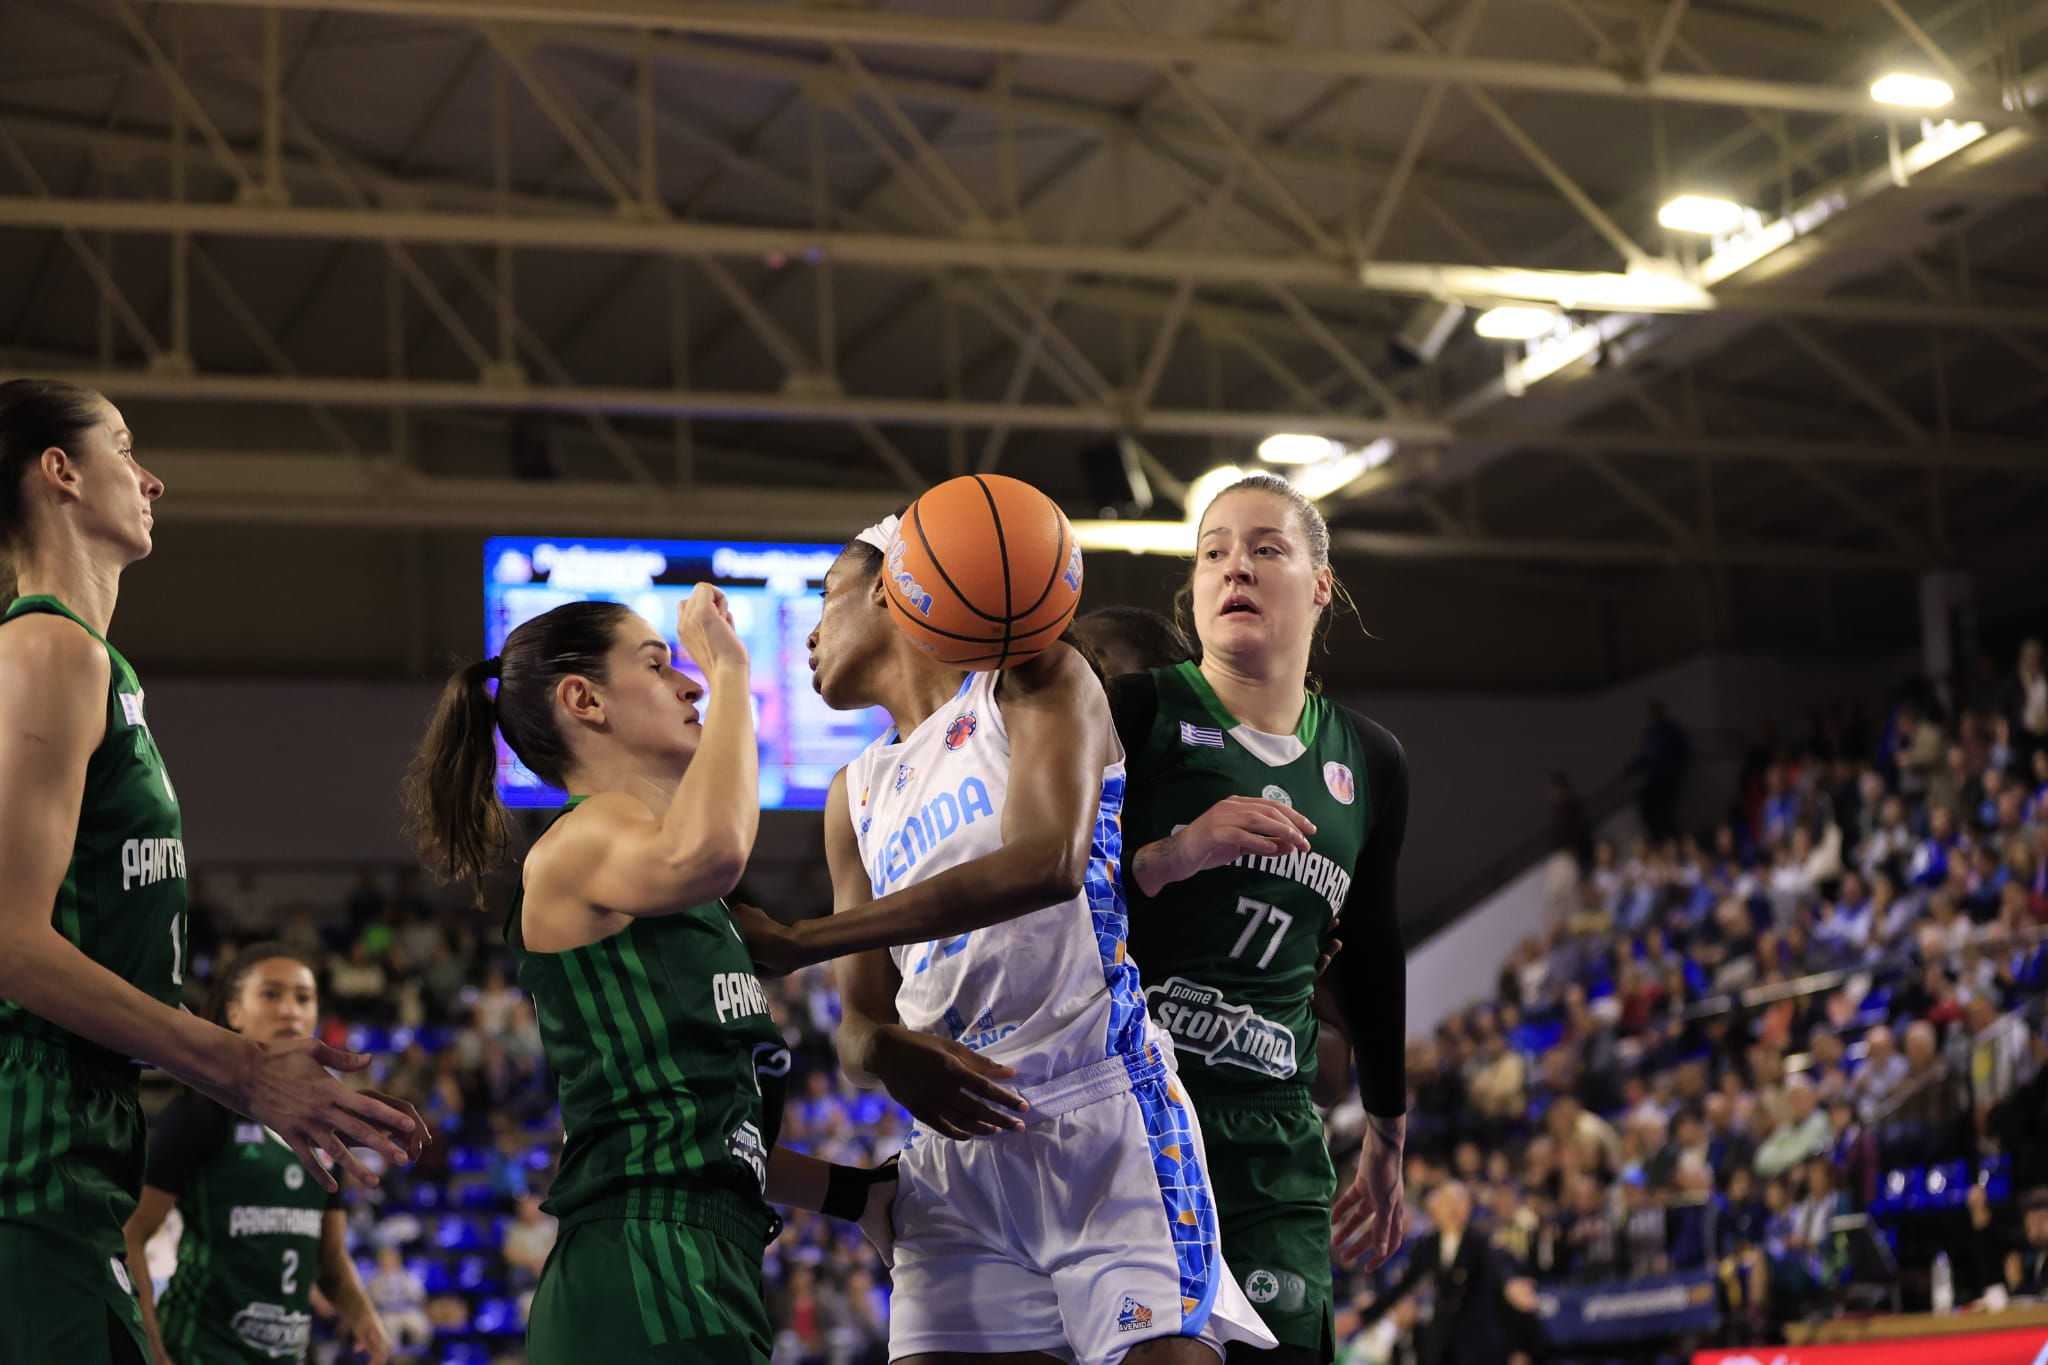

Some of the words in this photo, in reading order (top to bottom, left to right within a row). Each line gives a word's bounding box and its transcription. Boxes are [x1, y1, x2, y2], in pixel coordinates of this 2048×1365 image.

[168, 911, 187, 985] 1
[1228, 895, 1294, 970] 77
[712, 972, 775, 1023] PANA
[1170, 985, 1212, 1005] pame
[281, 1249, 299, 1294] 2
[1118, 1320, 1152, 1332] AVENIDA
